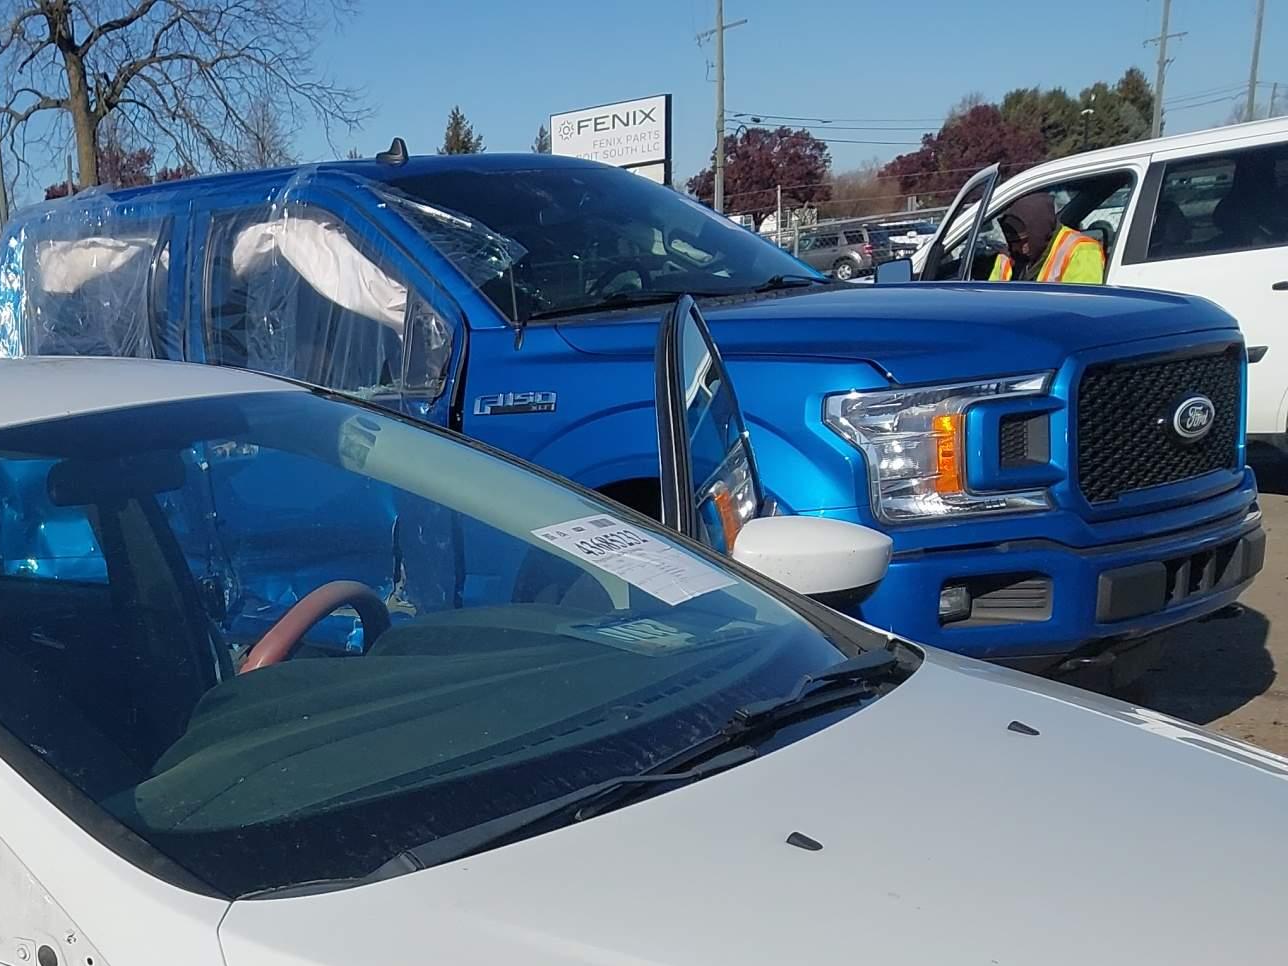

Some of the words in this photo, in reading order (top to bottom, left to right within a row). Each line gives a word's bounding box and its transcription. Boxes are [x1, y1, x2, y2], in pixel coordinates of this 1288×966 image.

[577, 107, 656, 135] FENIX
[593, 134, 623, 149] FENIX
[626, 130, 660, 145] PARTS
[602, 146, 638, 159] SOUTH
[641, 141, 660, 153] LLC
[1186, 405, 1209, 429] Ford
